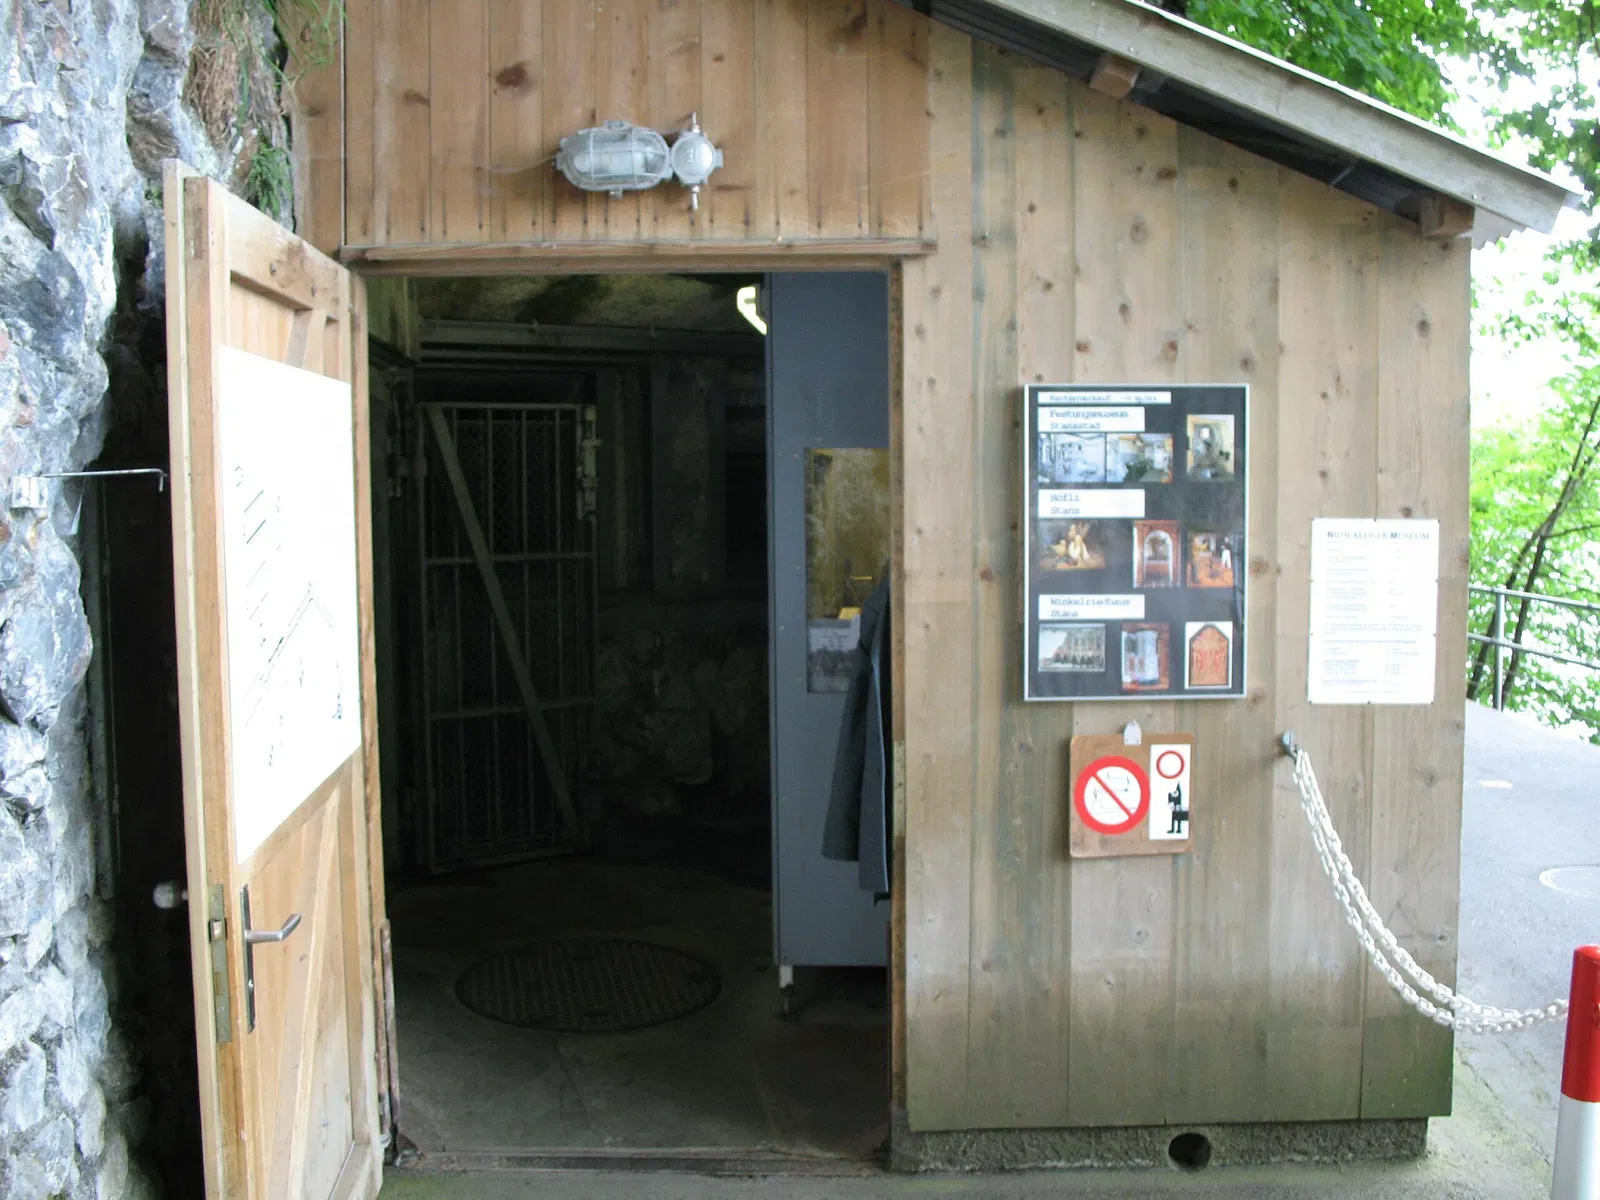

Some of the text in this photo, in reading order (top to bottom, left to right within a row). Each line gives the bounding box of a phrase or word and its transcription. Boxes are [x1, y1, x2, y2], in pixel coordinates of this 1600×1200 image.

[1050, 410, 1129, 419] Festungsmuseum
[1050, 506, 1081, 515] Stans
[1050, 609, 1079, 617] Stans
